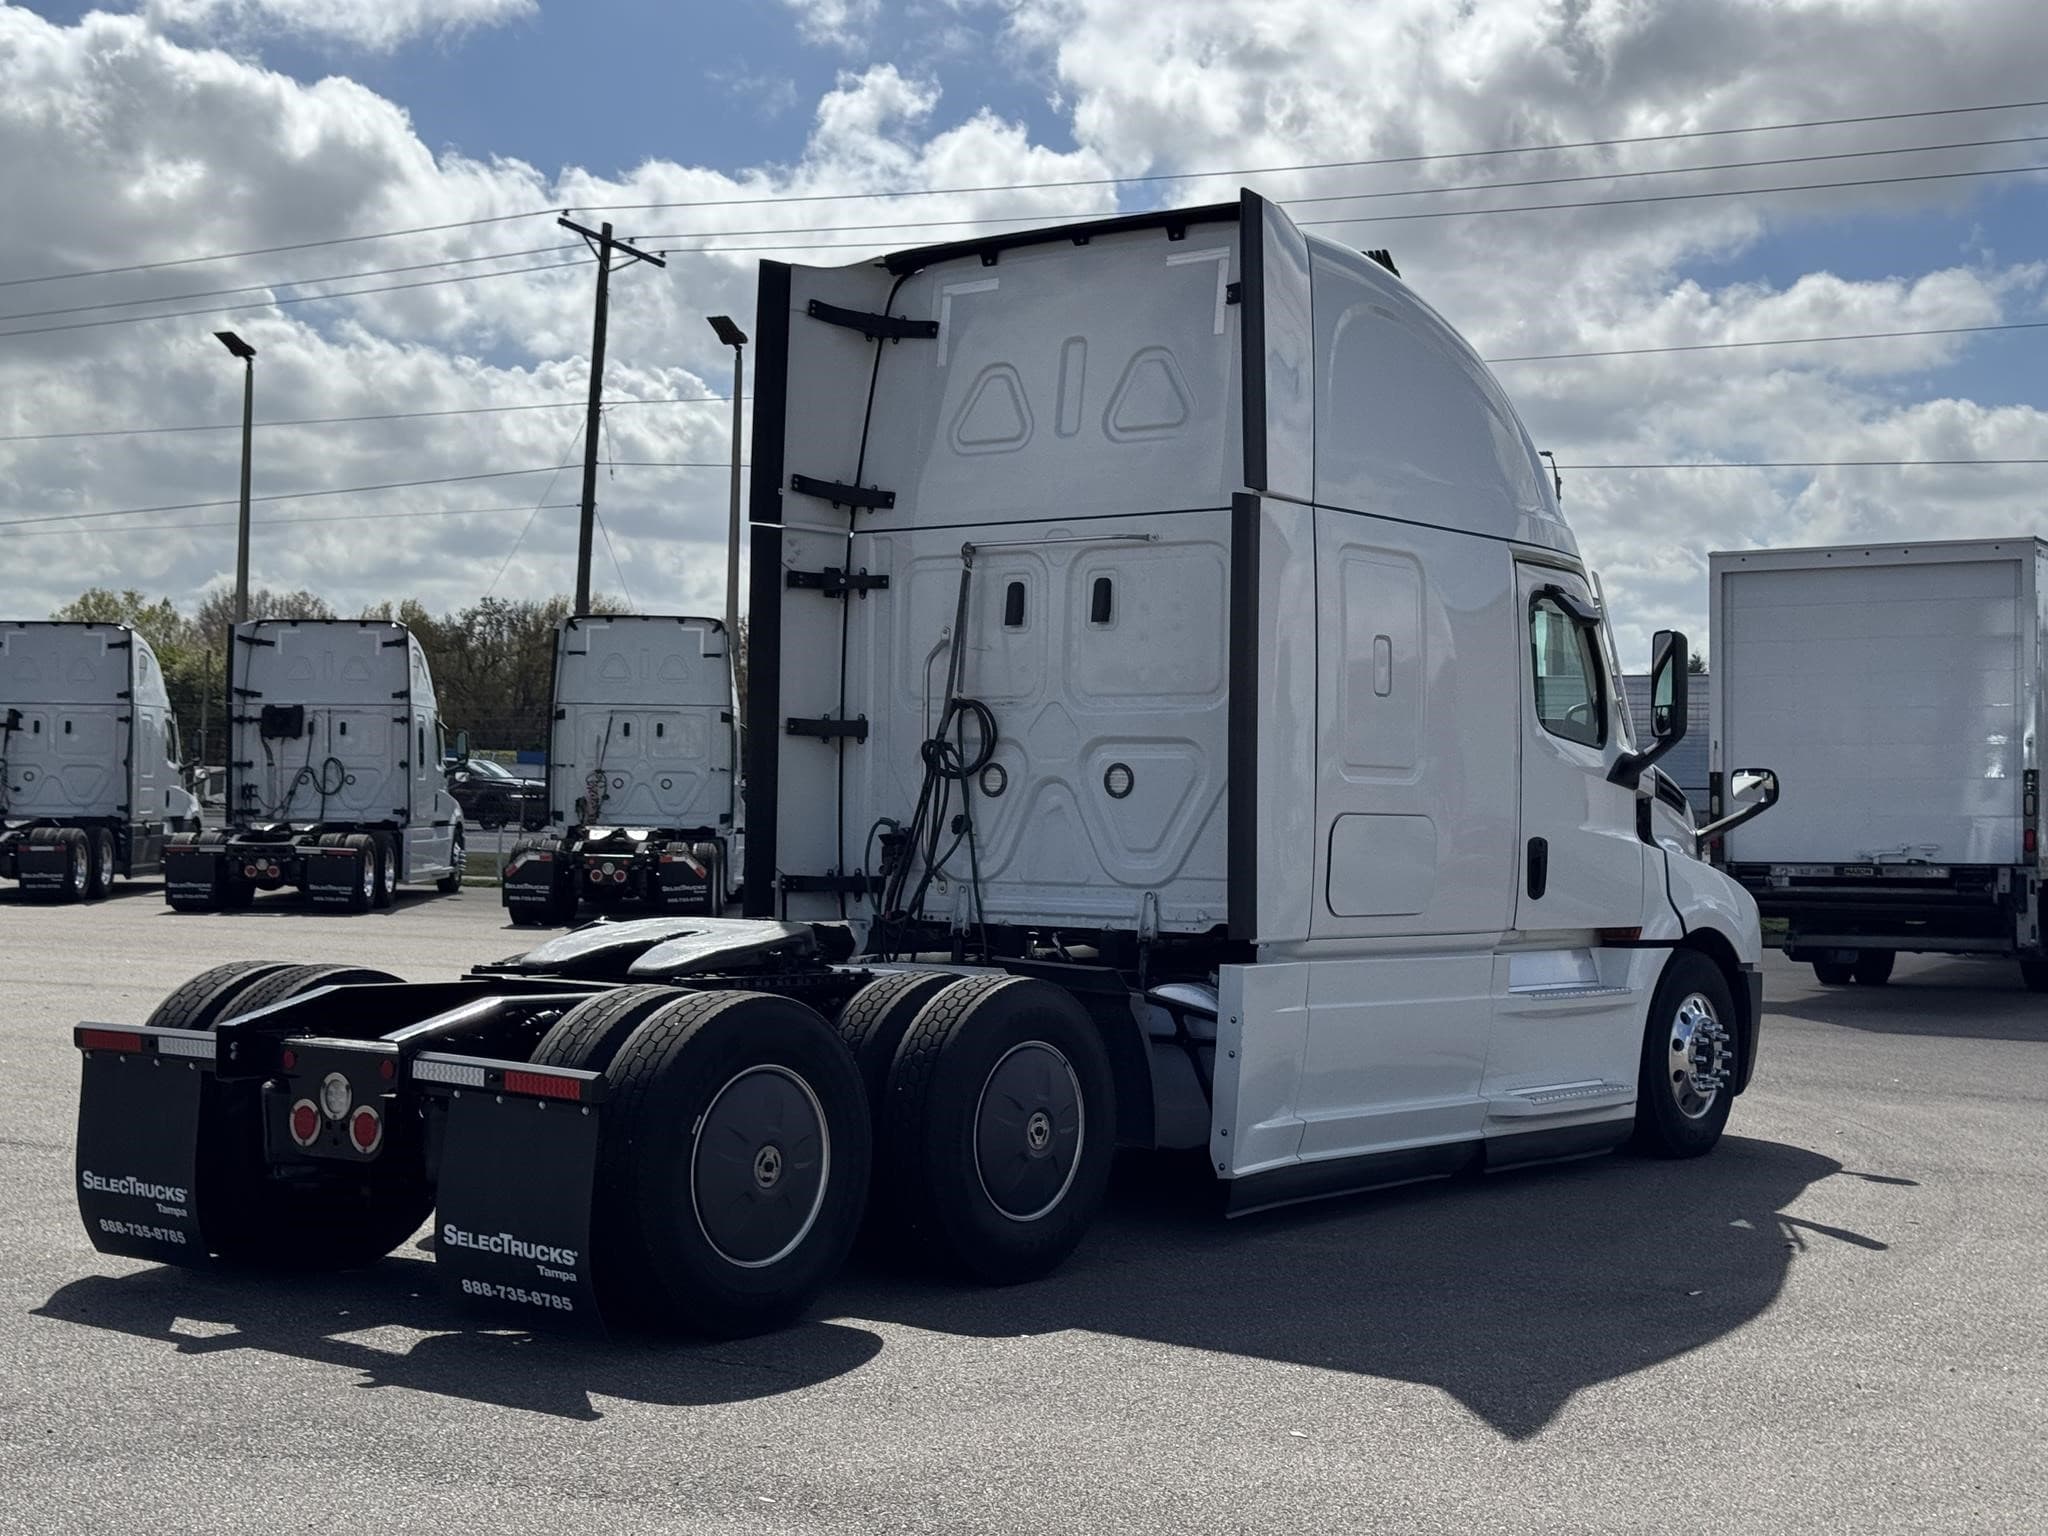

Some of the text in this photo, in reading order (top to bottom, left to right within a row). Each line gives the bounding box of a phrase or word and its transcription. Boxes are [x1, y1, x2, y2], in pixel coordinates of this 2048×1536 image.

[82, 1170, 188, 1203] SELECTRUCKS
[155, 1203, 188, 1218] Tampa
[99, 1218, 186, 1244] 888-735-8785
[443, 1223, 578, 1266] SELECTRUCKS
[536, 1264, 577, 1282] Tampa
[461, 1278, 573, 1311] 888-735-8785
